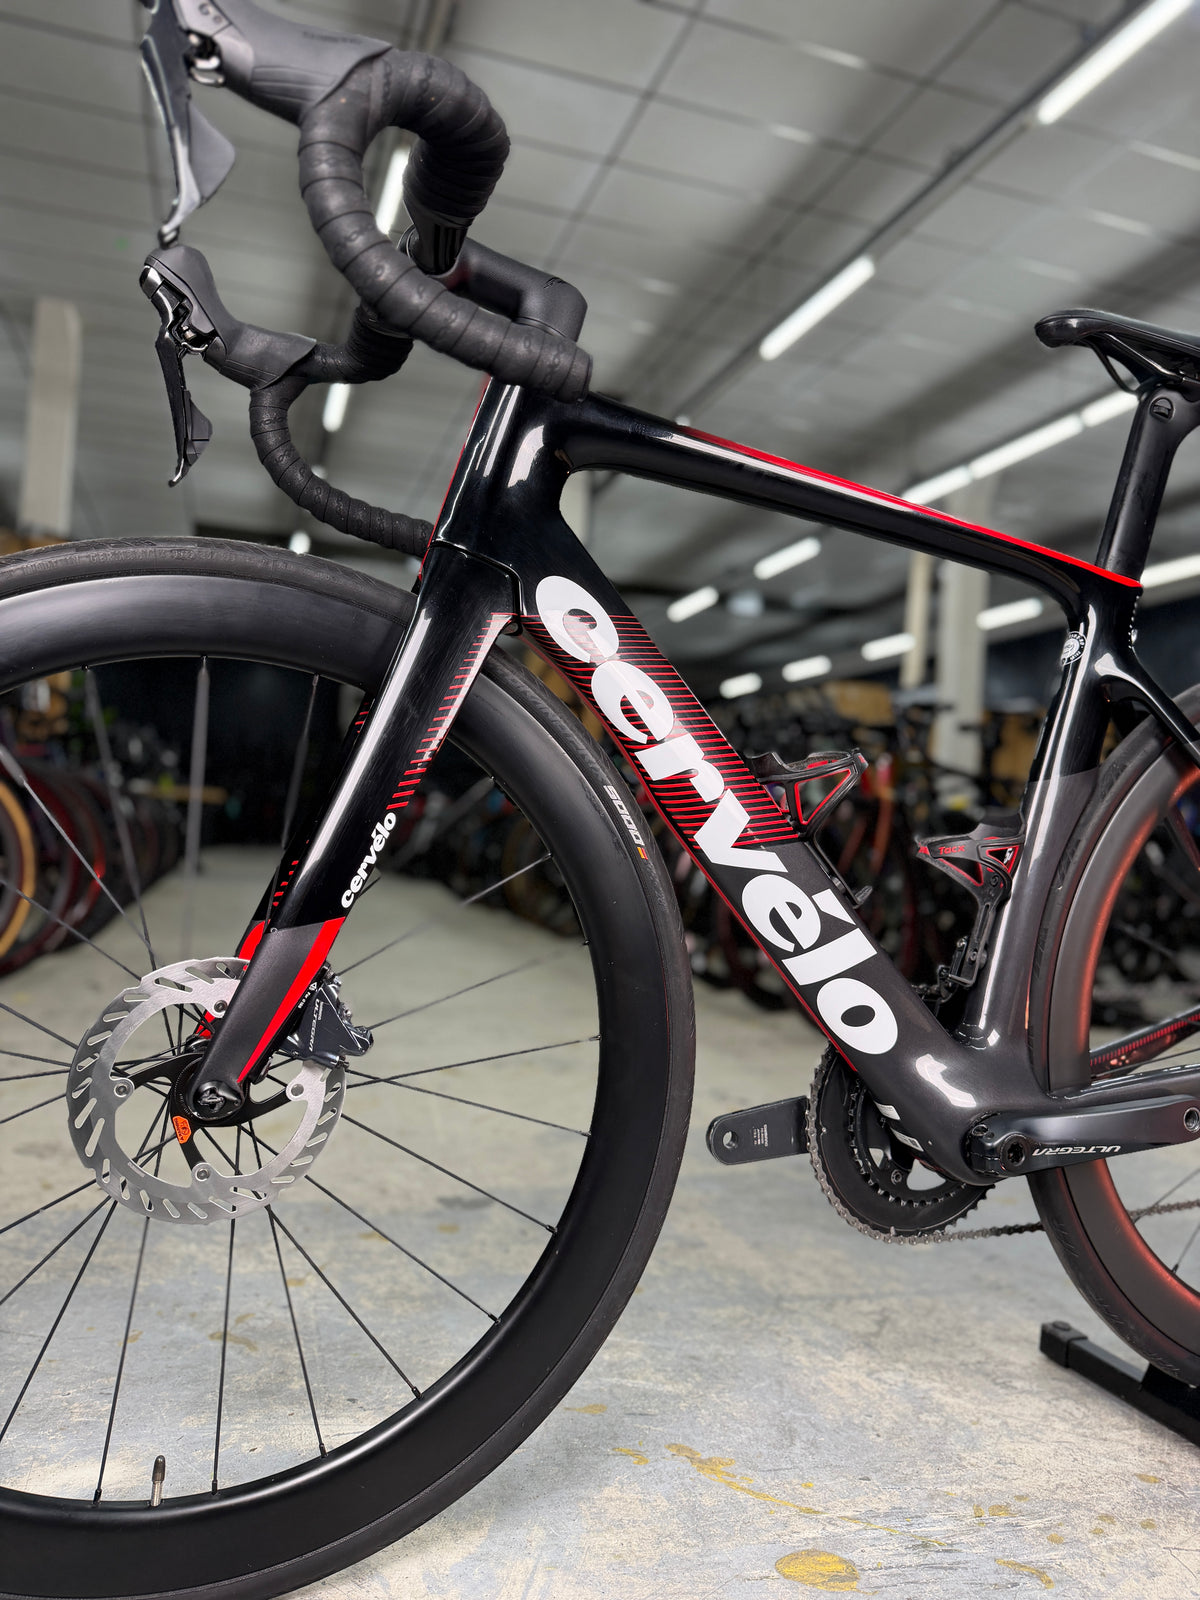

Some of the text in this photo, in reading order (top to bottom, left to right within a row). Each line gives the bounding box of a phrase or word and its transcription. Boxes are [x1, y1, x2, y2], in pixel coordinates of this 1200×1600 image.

[536, 576, 898, 1055] cervélo
[603, 785, 646, 846] 5000
[341, 811, 397, 909] cervélo
[938, 845, 966, 855] Tacx
[309, 998, 321, 1052] ULTEGRA
[1032, 1145, 1122, 1157] ULTEGRA
